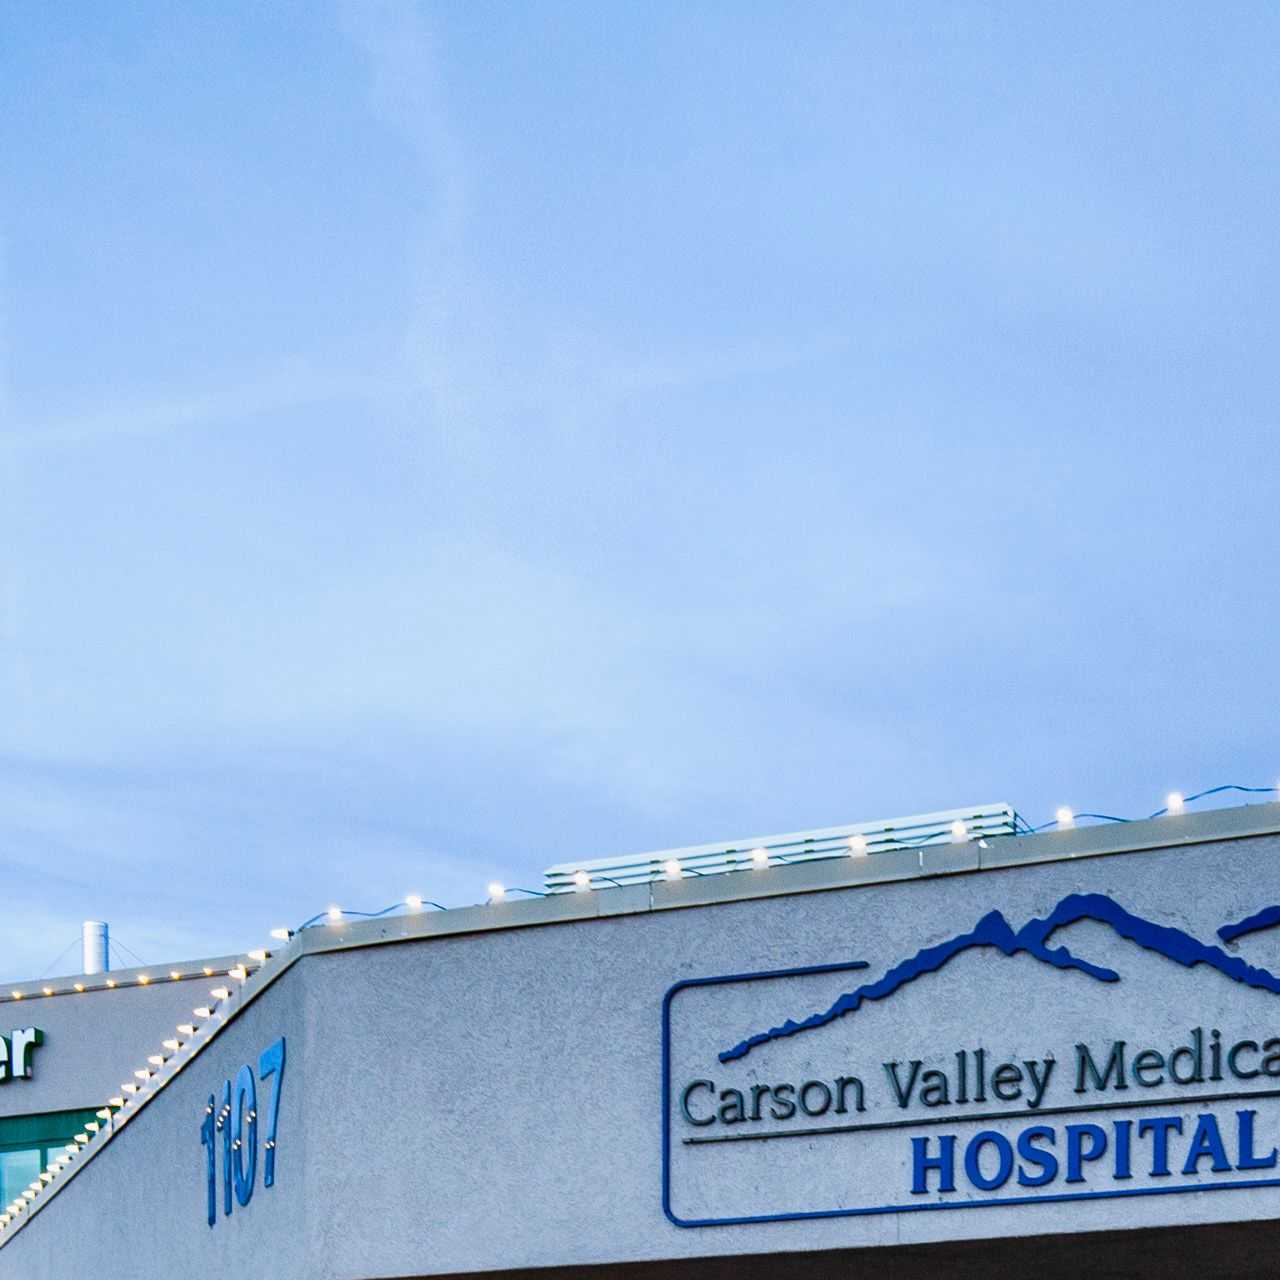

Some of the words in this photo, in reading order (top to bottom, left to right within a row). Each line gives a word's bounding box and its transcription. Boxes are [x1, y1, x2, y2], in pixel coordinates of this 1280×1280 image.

[200, 1036, 286, 1230] 1107
[680, 1076, 867, 1127] Carson
[881, 1055, 1053, 1108] Valley
[909, 1109, 1279, 1196] HOSPITAL
